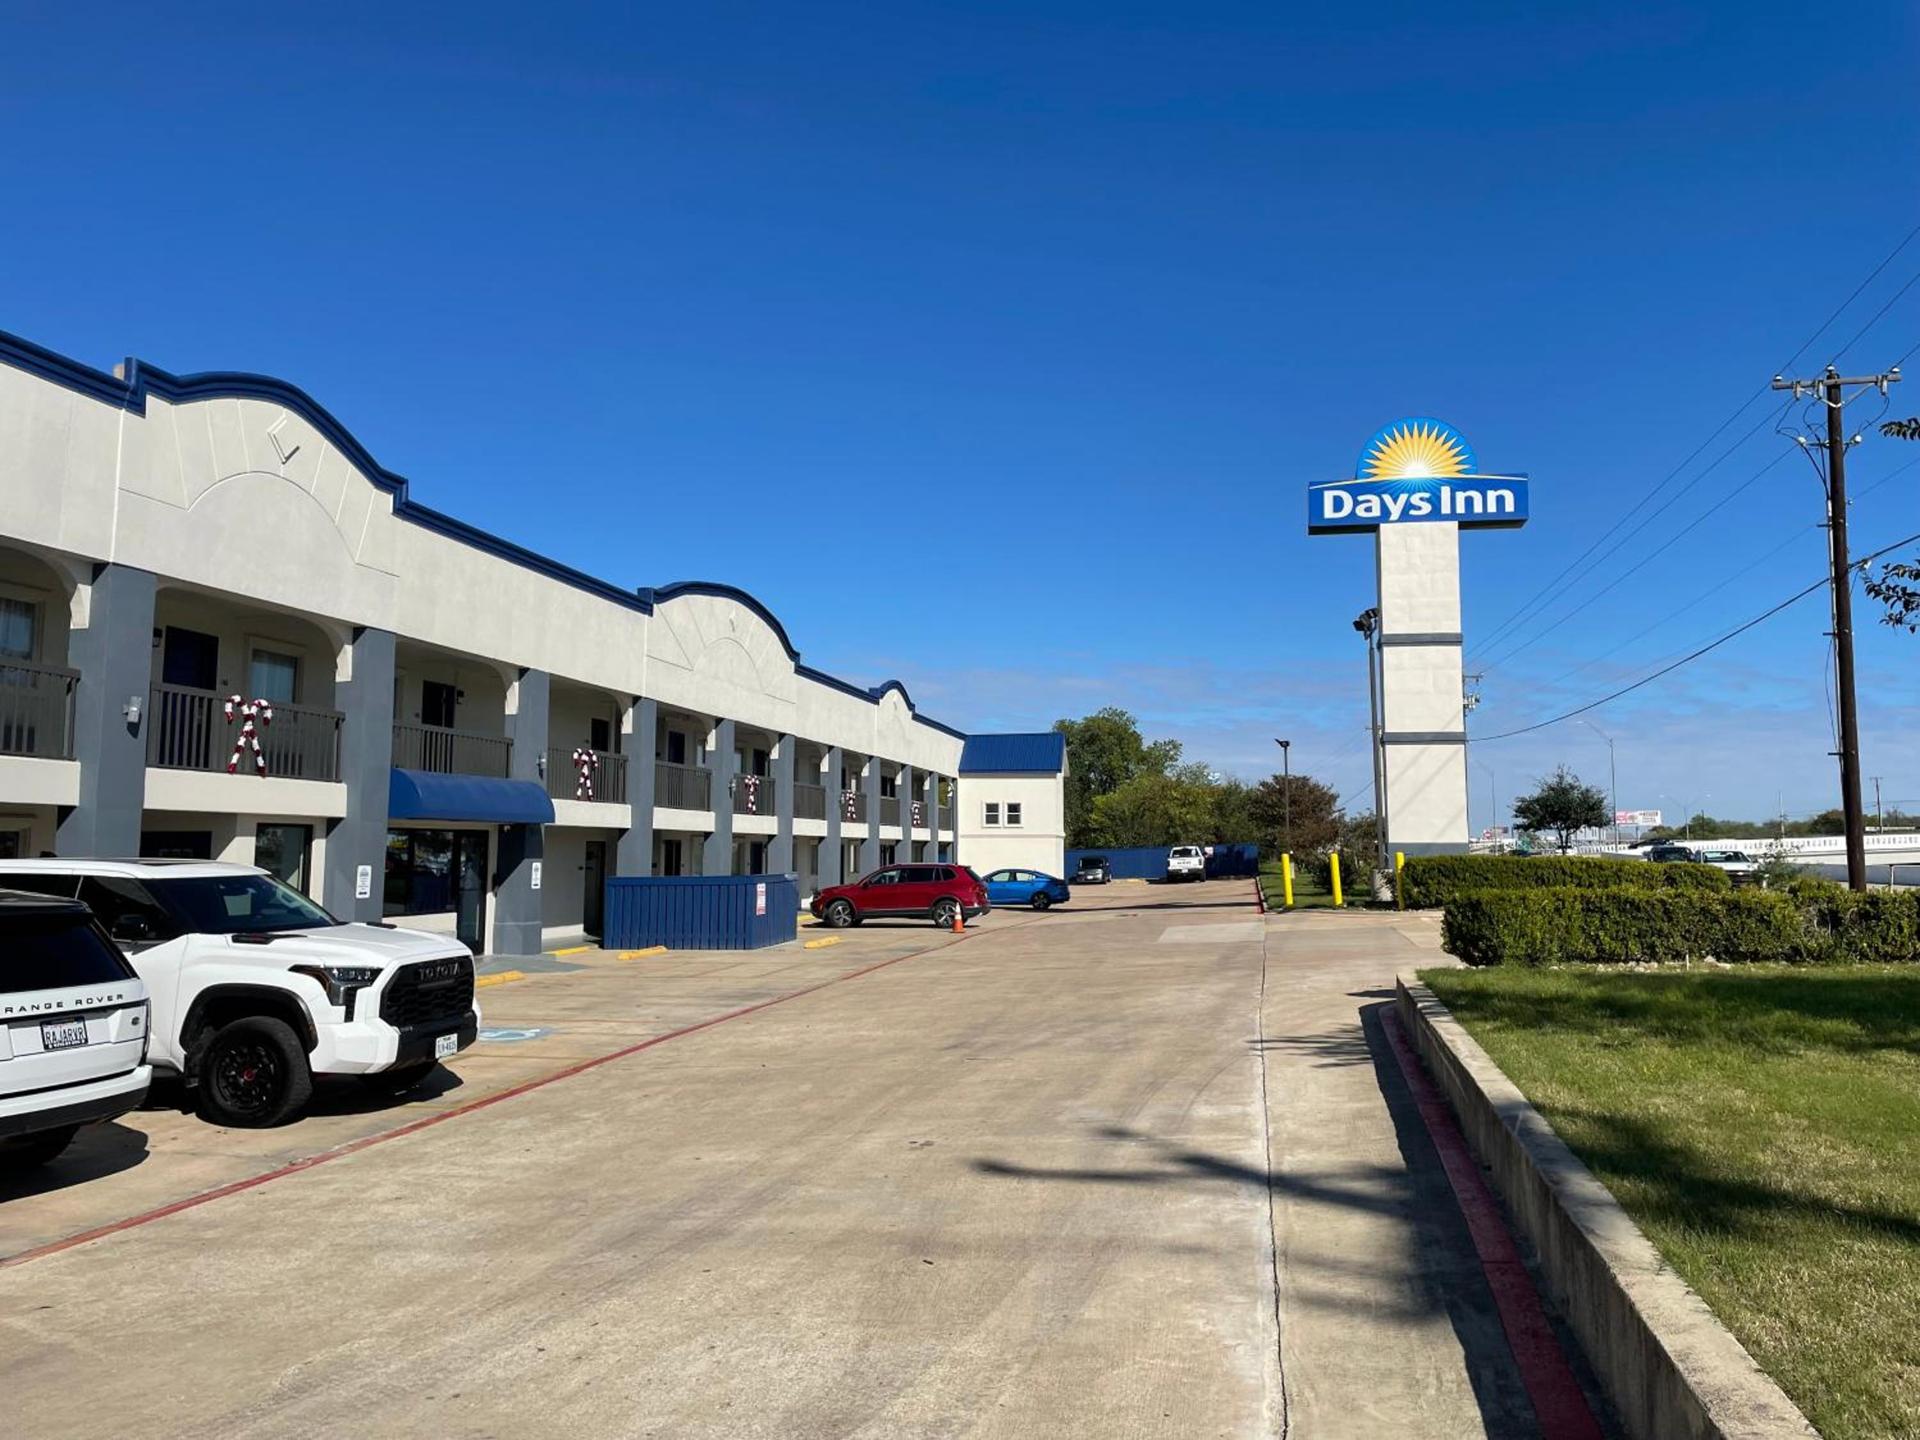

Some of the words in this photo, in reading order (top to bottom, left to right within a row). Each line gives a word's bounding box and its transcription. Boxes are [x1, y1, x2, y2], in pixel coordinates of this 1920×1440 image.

[1323, 489, 1432, 521] Days
[1440, 486, 1515, 515] Inn
[419, 962, 461, 980] TOYOTA
[4, 1001, 63, 1013] RANGE
[75, 994, 124, 1006] ROVER
